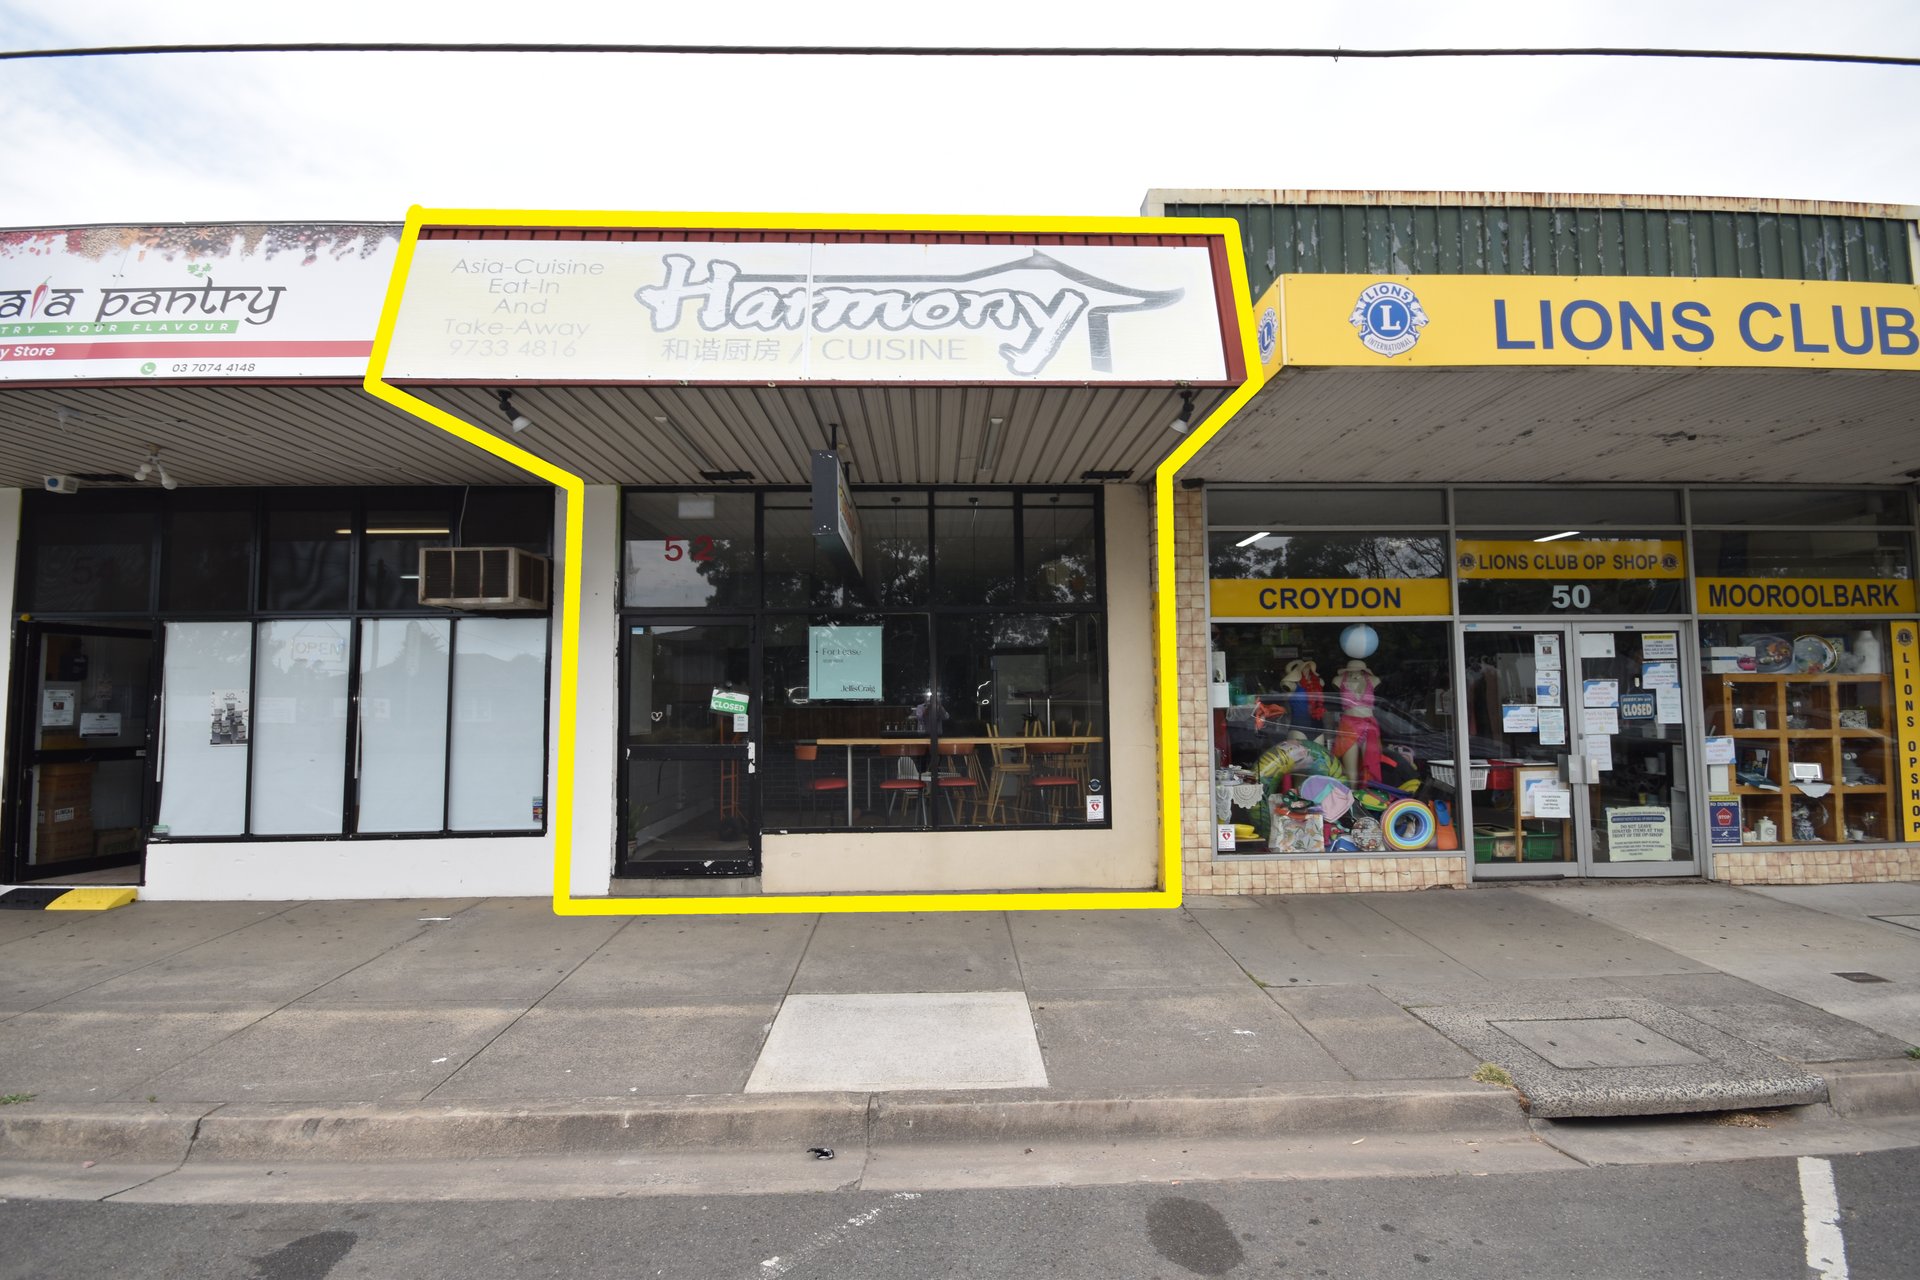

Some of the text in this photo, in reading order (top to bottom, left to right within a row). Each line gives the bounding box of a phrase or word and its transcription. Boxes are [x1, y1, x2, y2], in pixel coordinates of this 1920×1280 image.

[450, 258, 605, 276] Asia-Cuisine
[488, 278, 561, 294] Eat-In
[1365, 285, 1410, 301] LIONS
[94, 275, 288, 326] pantry
[491, 298, 549, 315] And
[634, 253, 1090, 376] Harmony
[1380, 304, 1402, 331] L
[131, 322, 230, 332] FLAVOUR
[443, 318, 592, 340] Take-Away
[1494, 299, 1920, 356] LIONS CLUB
[13, 345, 56, 358] Store
[448, 339, 578, 358] 9733 4816
[661, 337, 782, 362] 和谐厨房
[822, 337, 969, 362] CUISINE
[1367, 337, 1413, 351] INTERNATIONAL
[172, 362, 256, 373] 03 7074 4148
[664, 535, 714, 562] 52
[1479, 554, 1529, 571] LIONS
[1533, 554, 1579, 571] CLUB
[1583, 554, 1606, 570] OP
[1612, 553, 1658, 570] SHOP
[1258, 587, 1402, 610] CROYDON
[1551, 584, 1591, 609] 50
[1708, 584, 1900, 608] MOOROOLBARK
[1902, 652, 1915, 728] LIONS
[713, 700, 746, 713] CLOSED
[1623, 703, 1653, 717] CLOSED
